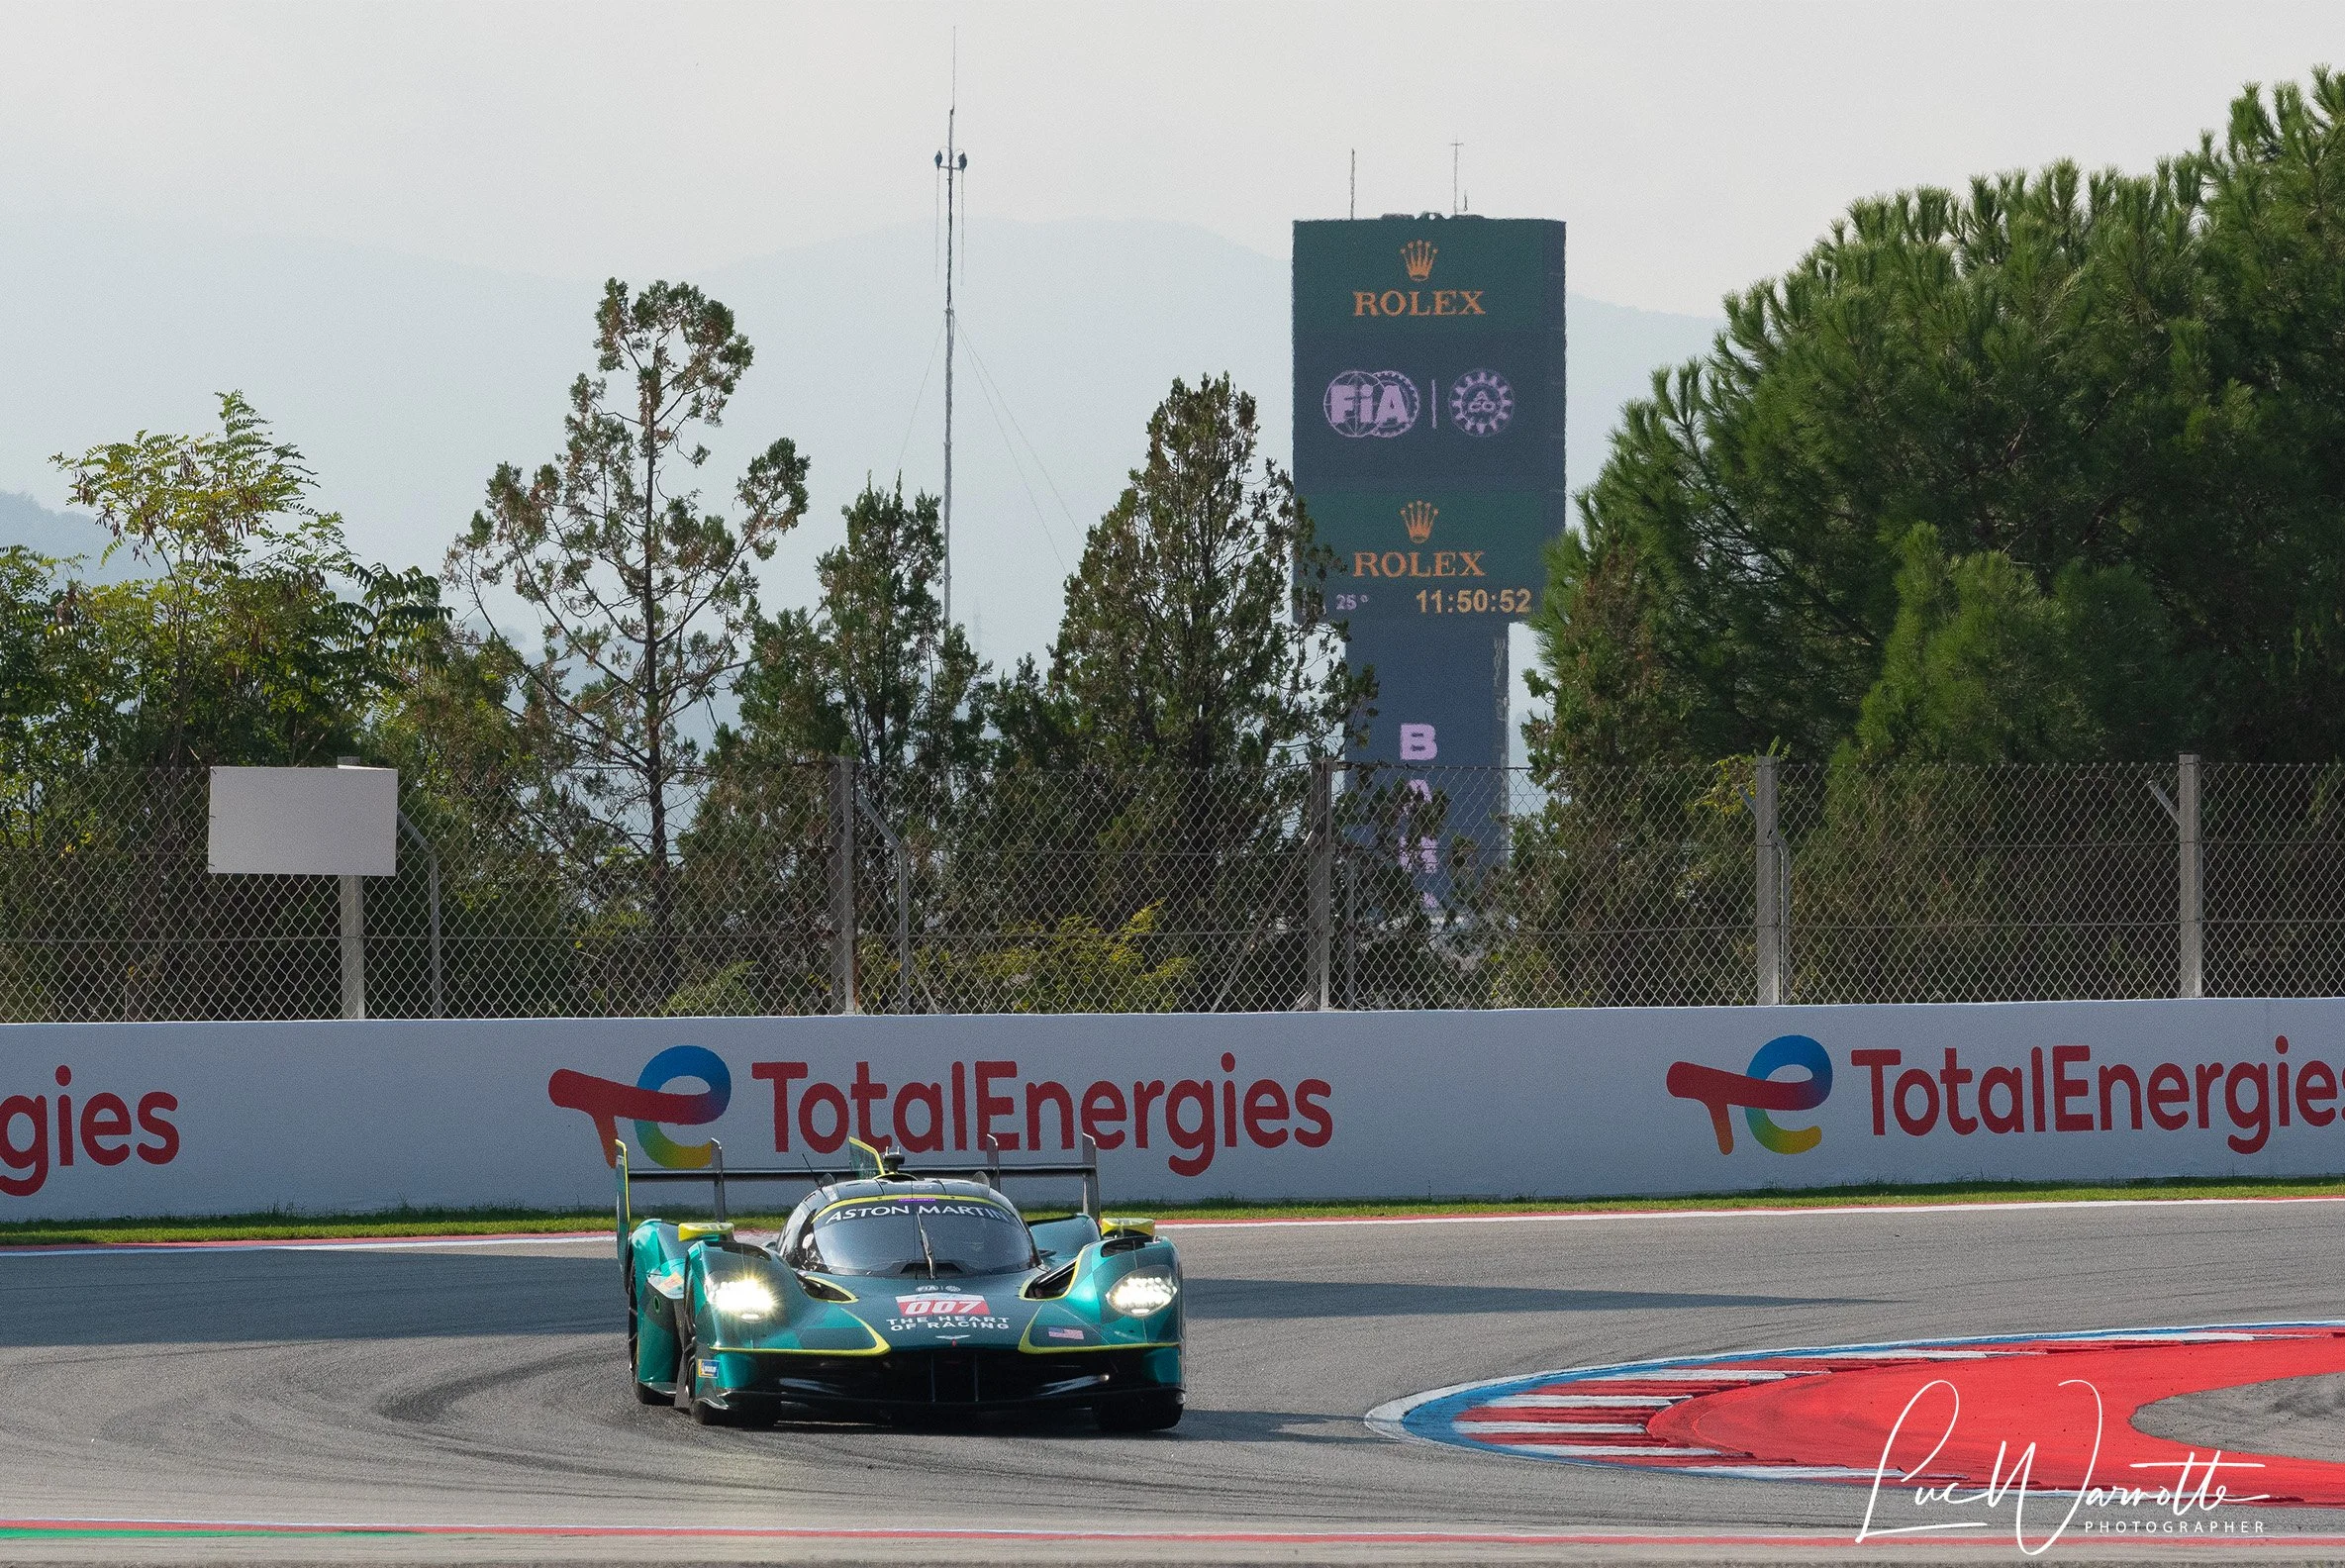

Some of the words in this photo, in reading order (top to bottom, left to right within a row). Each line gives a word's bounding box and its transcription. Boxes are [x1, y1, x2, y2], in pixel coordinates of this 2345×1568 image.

[1352, 290, 1486, 317] ROLEX
[1353, 551, 1486, 578] ROLEX
[1417, 589, 1532, 614] 11:50:52
[1851, 1035, 2345, 1154] TotalEnergie
[751, 1052, 1332, 1176] TotalEnergies
[826, 1205, 911, 1225] ASTON
[919, 1205, 1010, 1224] MARTIN
[886, 1316, 929, 1325] THE
[938, 1315, 1010, 1323] HEART
[905, 1301, 982, 1316] 007
[890, 1323, 917, 1331] OF
[927, 1321, 1010, 1329] RACING
